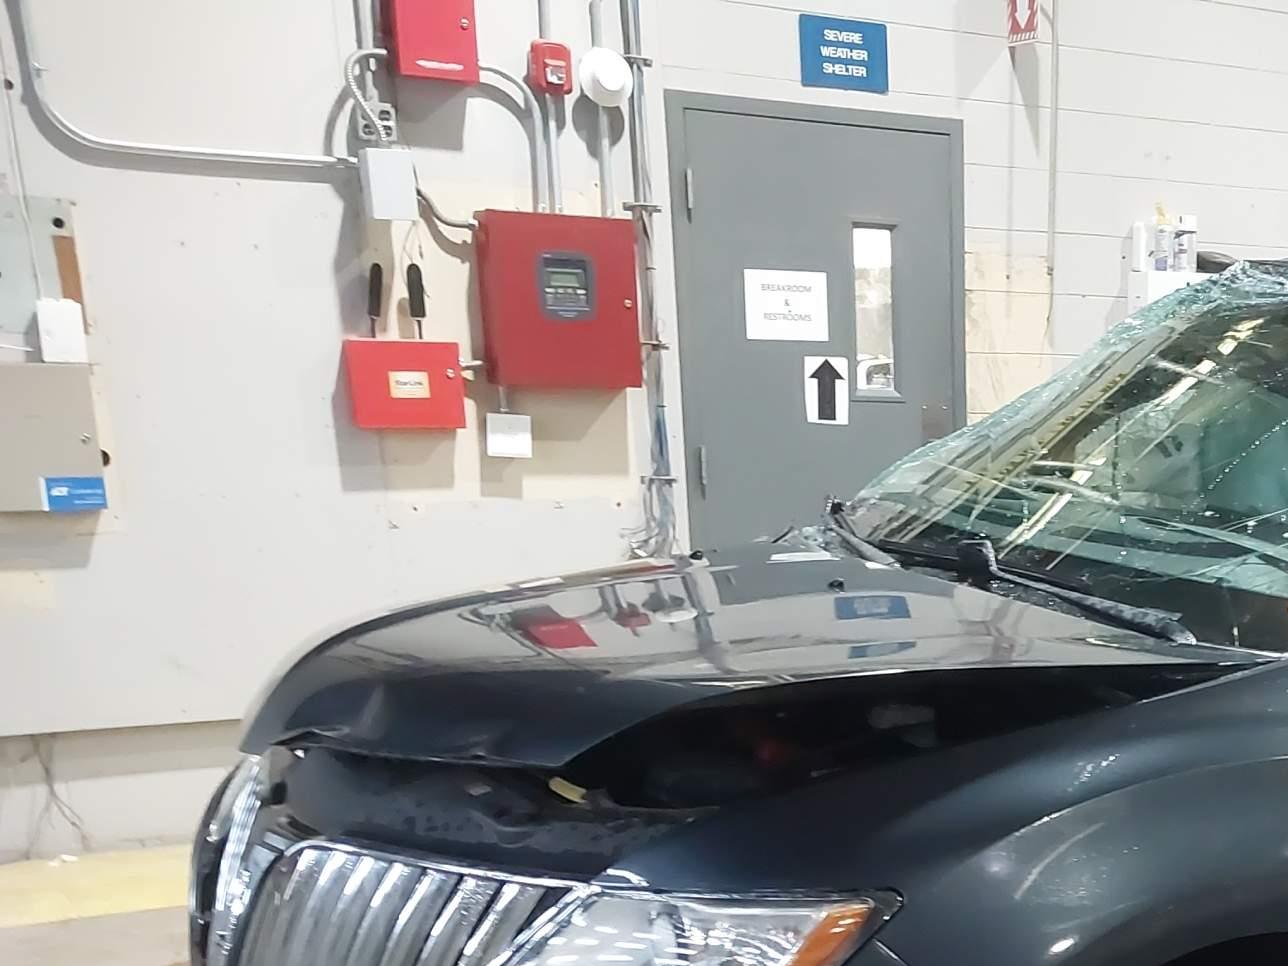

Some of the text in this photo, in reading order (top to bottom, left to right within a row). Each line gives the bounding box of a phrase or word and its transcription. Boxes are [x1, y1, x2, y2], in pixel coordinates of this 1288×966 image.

[823, 29, 864, 44] SEVERE
[820, 45, 869, 61] WEATHER
[822, 62, 867, 77] SHELTER
[760, 283, 812, 293] BREAKROOM
[763, 312, 813, 322] RESTROOMS
